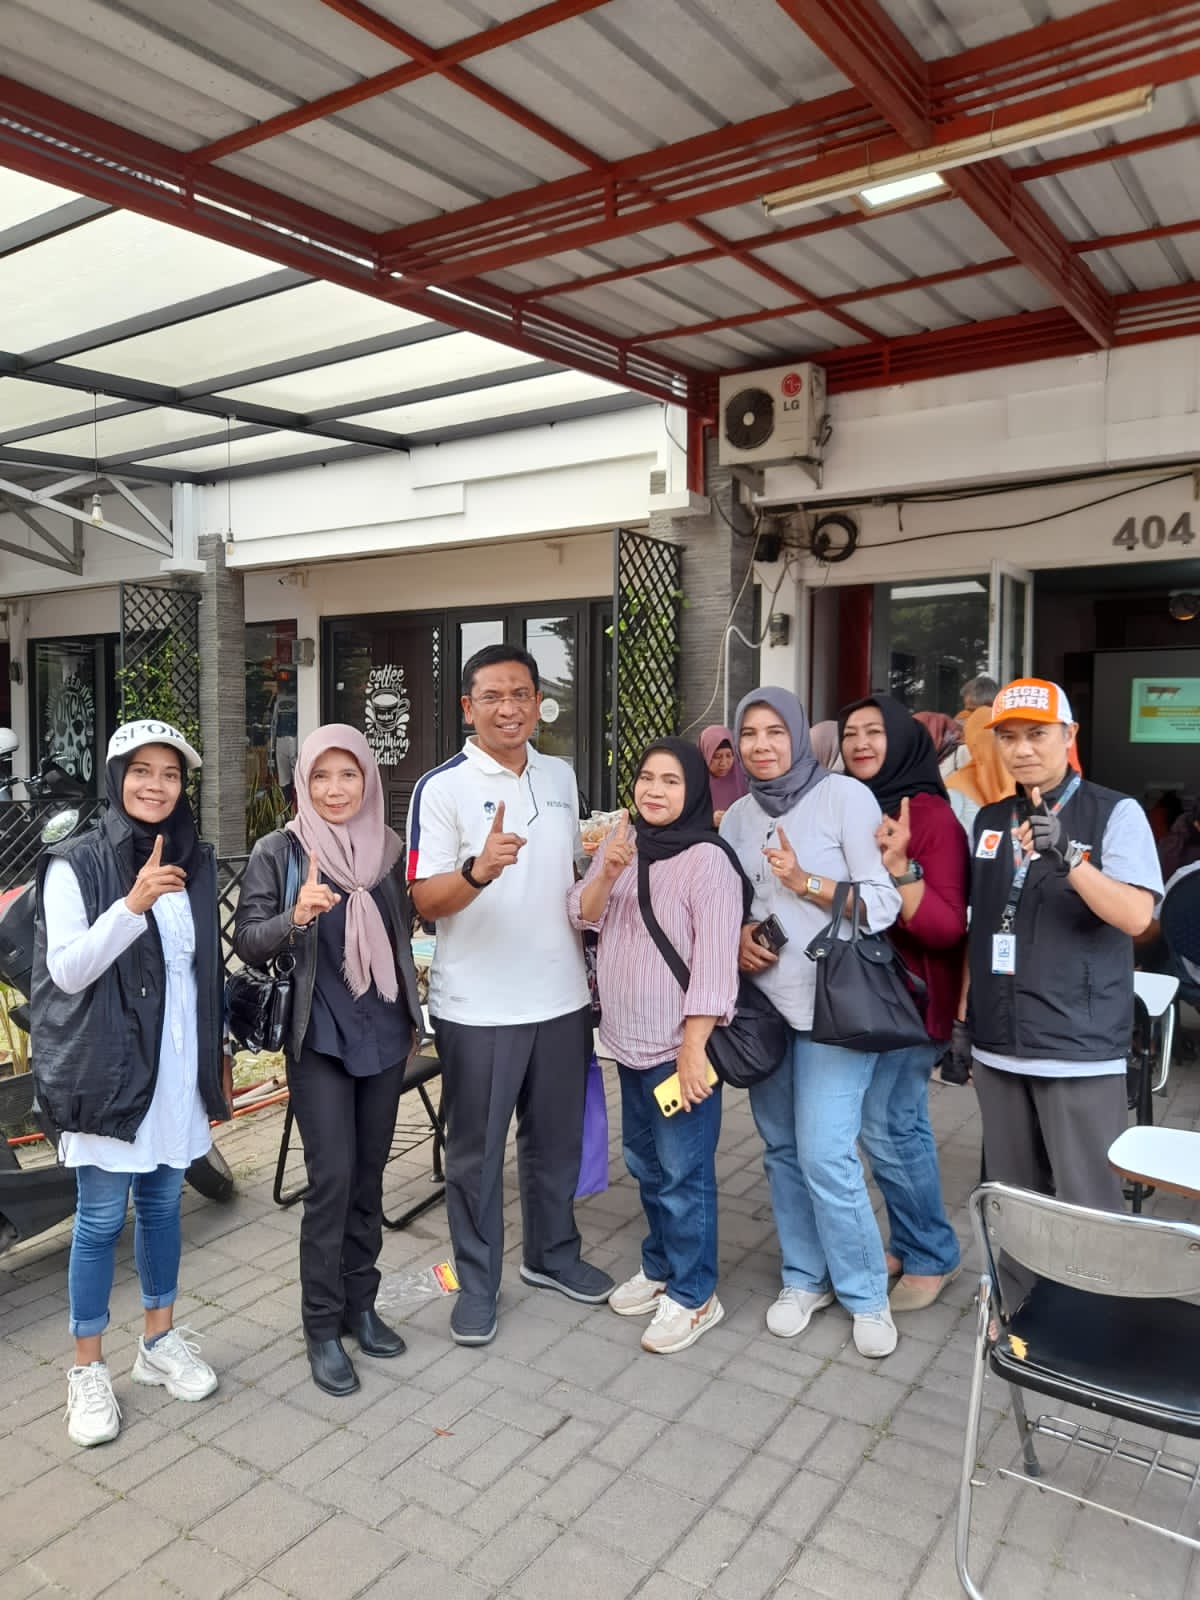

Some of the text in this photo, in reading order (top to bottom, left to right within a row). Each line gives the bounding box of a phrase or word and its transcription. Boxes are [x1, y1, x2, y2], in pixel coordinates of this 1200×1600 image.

[783, 400, 800, 412] LG
[1112, 511, 1196, 551] 404
[369, 664, 404, 688] coffee
[1004, 686, 1050, 699] SEGER
